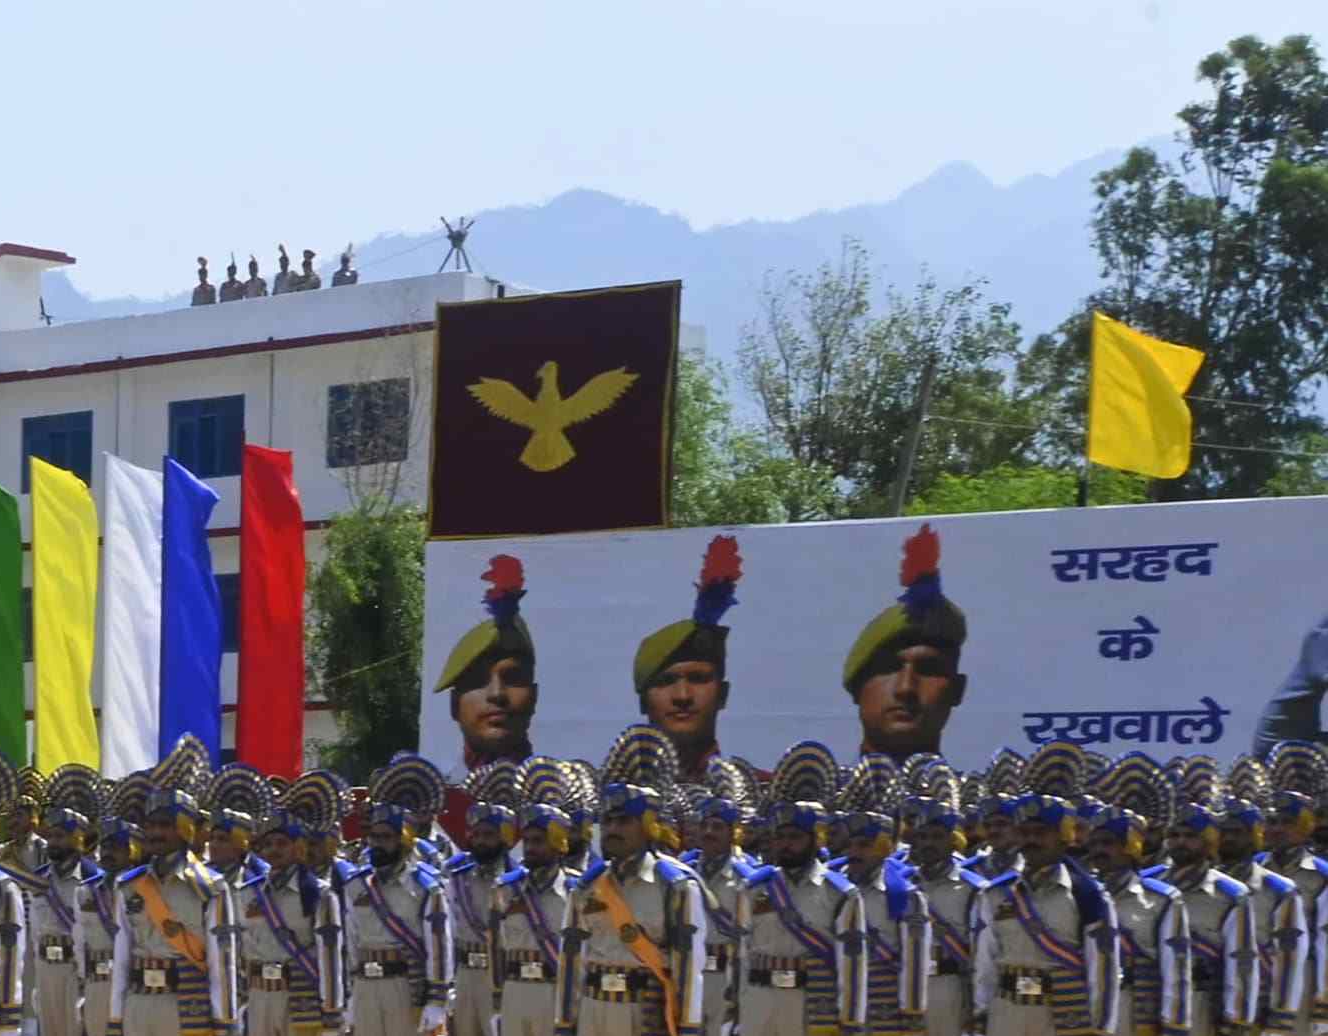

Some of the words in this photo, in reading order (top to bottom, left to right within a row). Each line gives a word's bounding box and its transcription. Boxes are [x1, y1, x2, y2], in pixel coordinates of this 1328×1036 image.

[1050, 542, 1219, 583] सरहद
[1097, 615, 1160, 661] के
[1022, 696, 1231, 745] रखवाले
